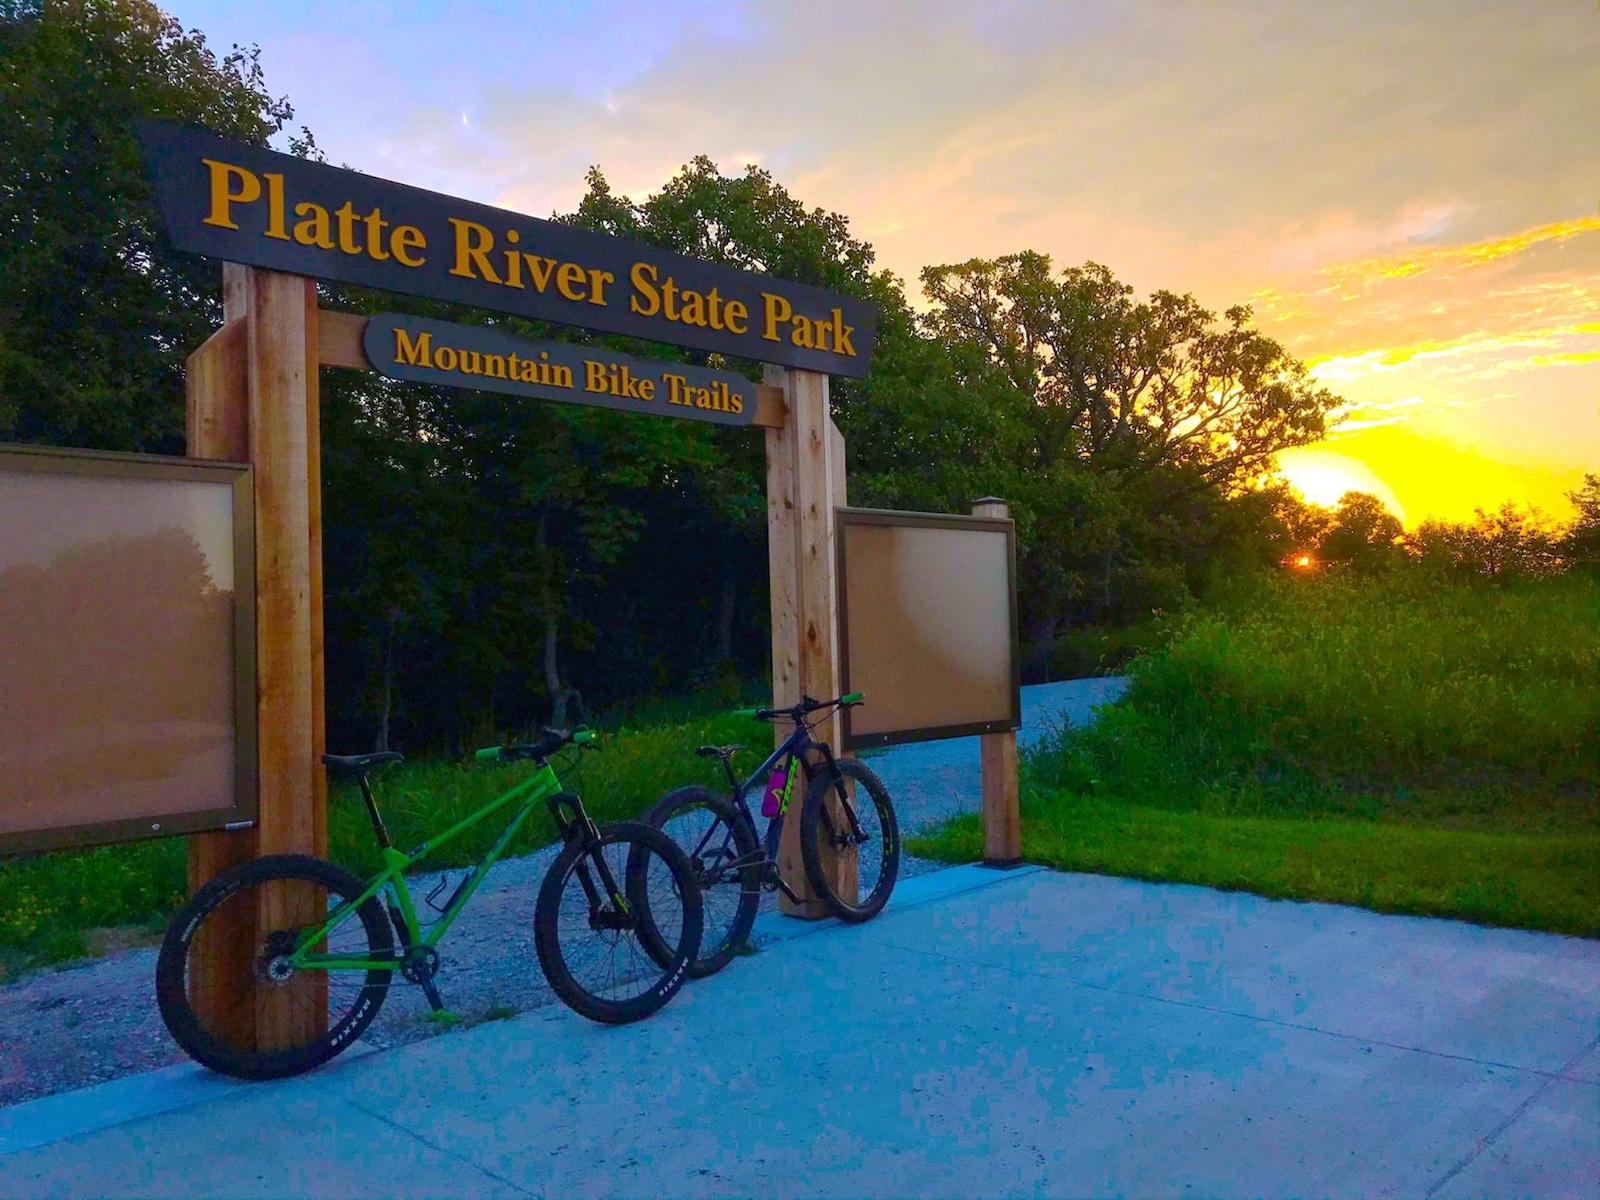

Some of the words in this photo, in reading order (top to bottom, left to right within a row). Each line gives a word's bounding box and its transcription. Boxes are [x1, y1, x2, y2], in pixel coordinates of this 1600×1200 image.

[202, 158, 427, 268] Platte
[448, 217, 614, 307] River
[630, 262, 748, 335] State
[760, 292, 857, 357] Park
[393, 328, 575, 389] Mountain
[583, 360, 655, 401] Bike
[662, 373, 743, 414] Trails
[658, 956, 689, 997] MAXXIS
[330, 998, 371, 1047] MAXXIS
